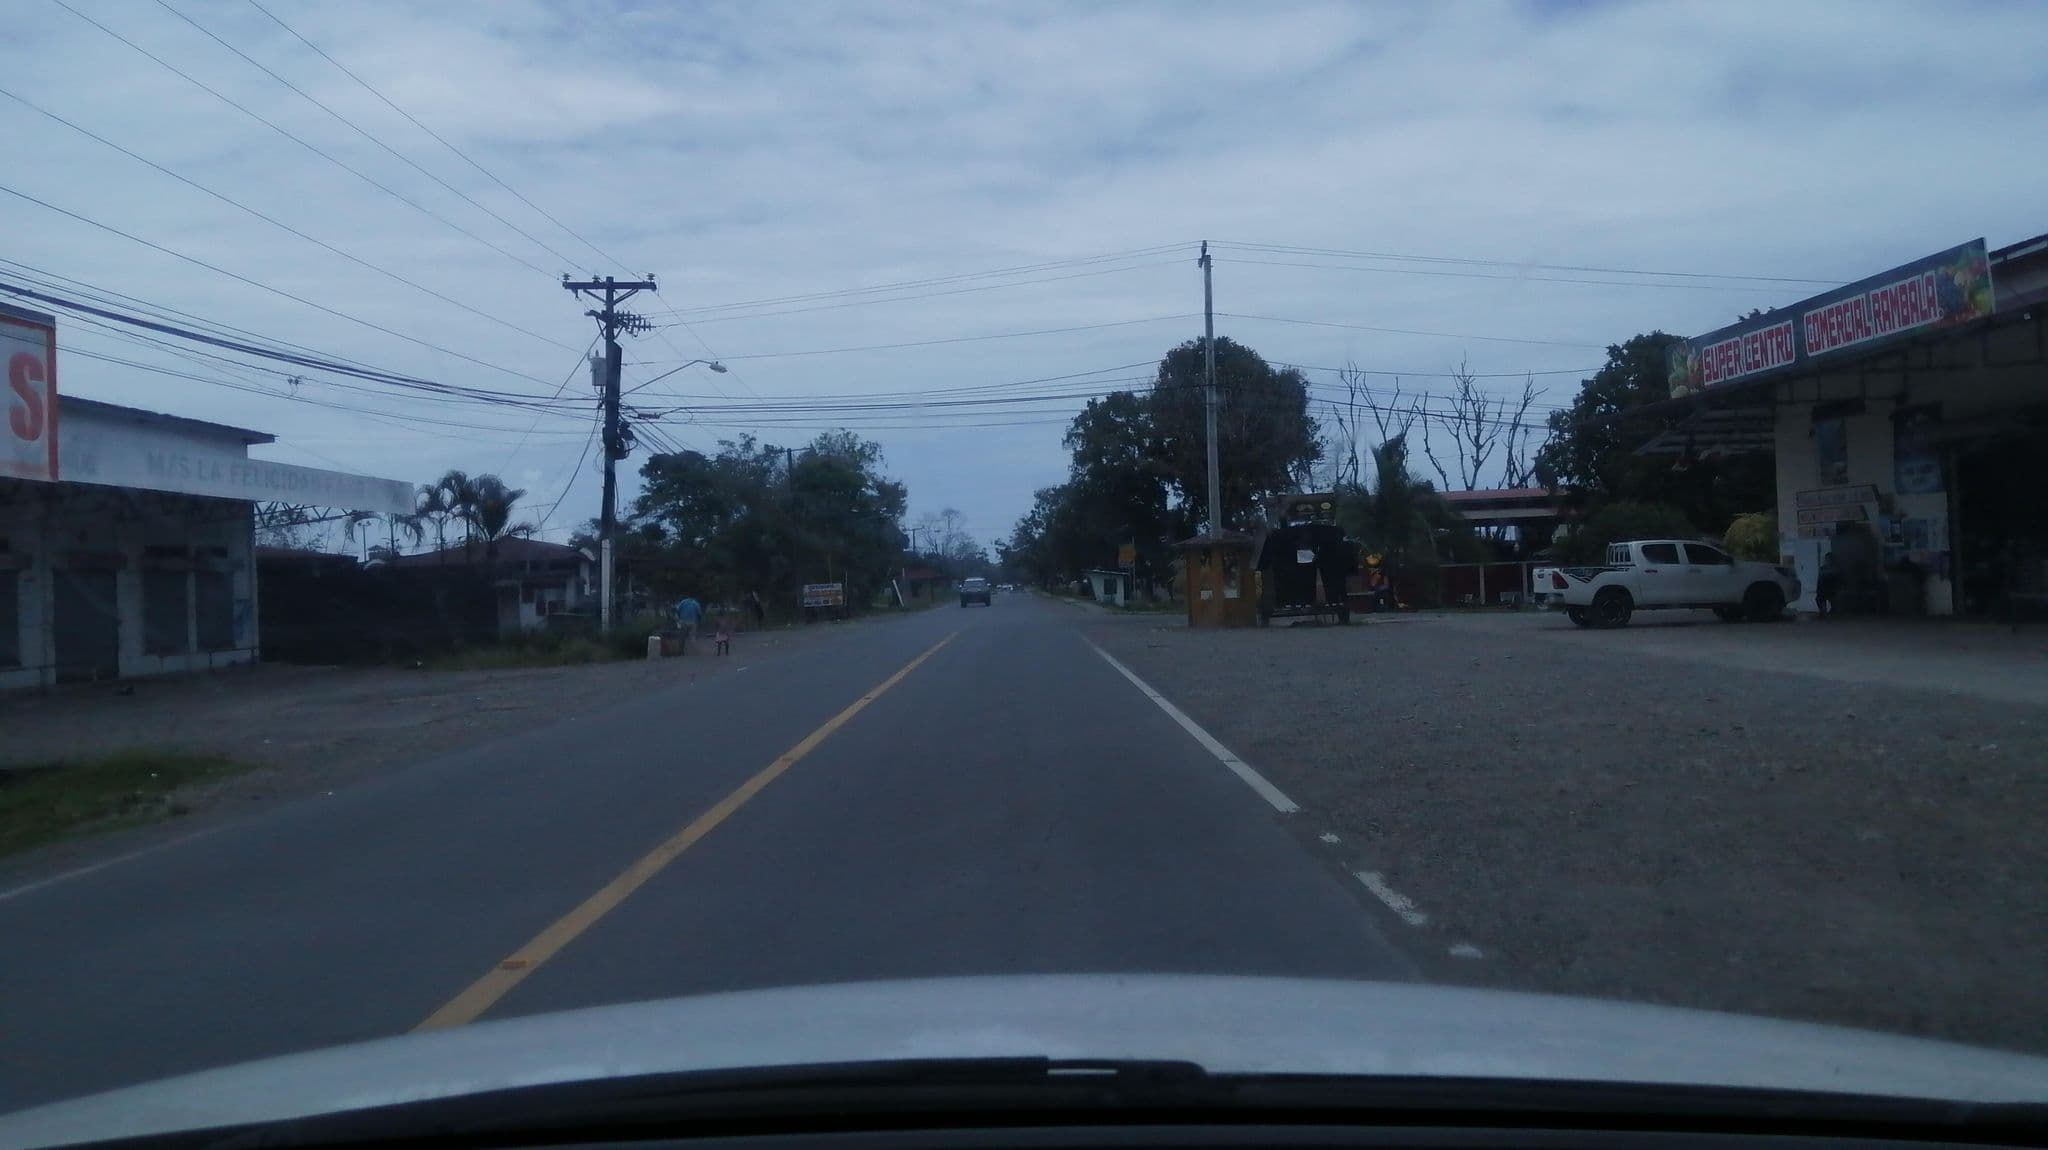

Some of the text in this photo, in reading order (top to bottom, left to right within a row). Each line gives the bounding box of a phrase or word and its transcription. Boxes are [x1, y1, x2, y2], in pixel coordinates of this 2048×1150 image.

[1704, 322, 1794, 383] SUPER CENTRO
[1805, 273, 1936, 355] COMERCIAL RAMBALA
[8, 351, 44, 441] S
